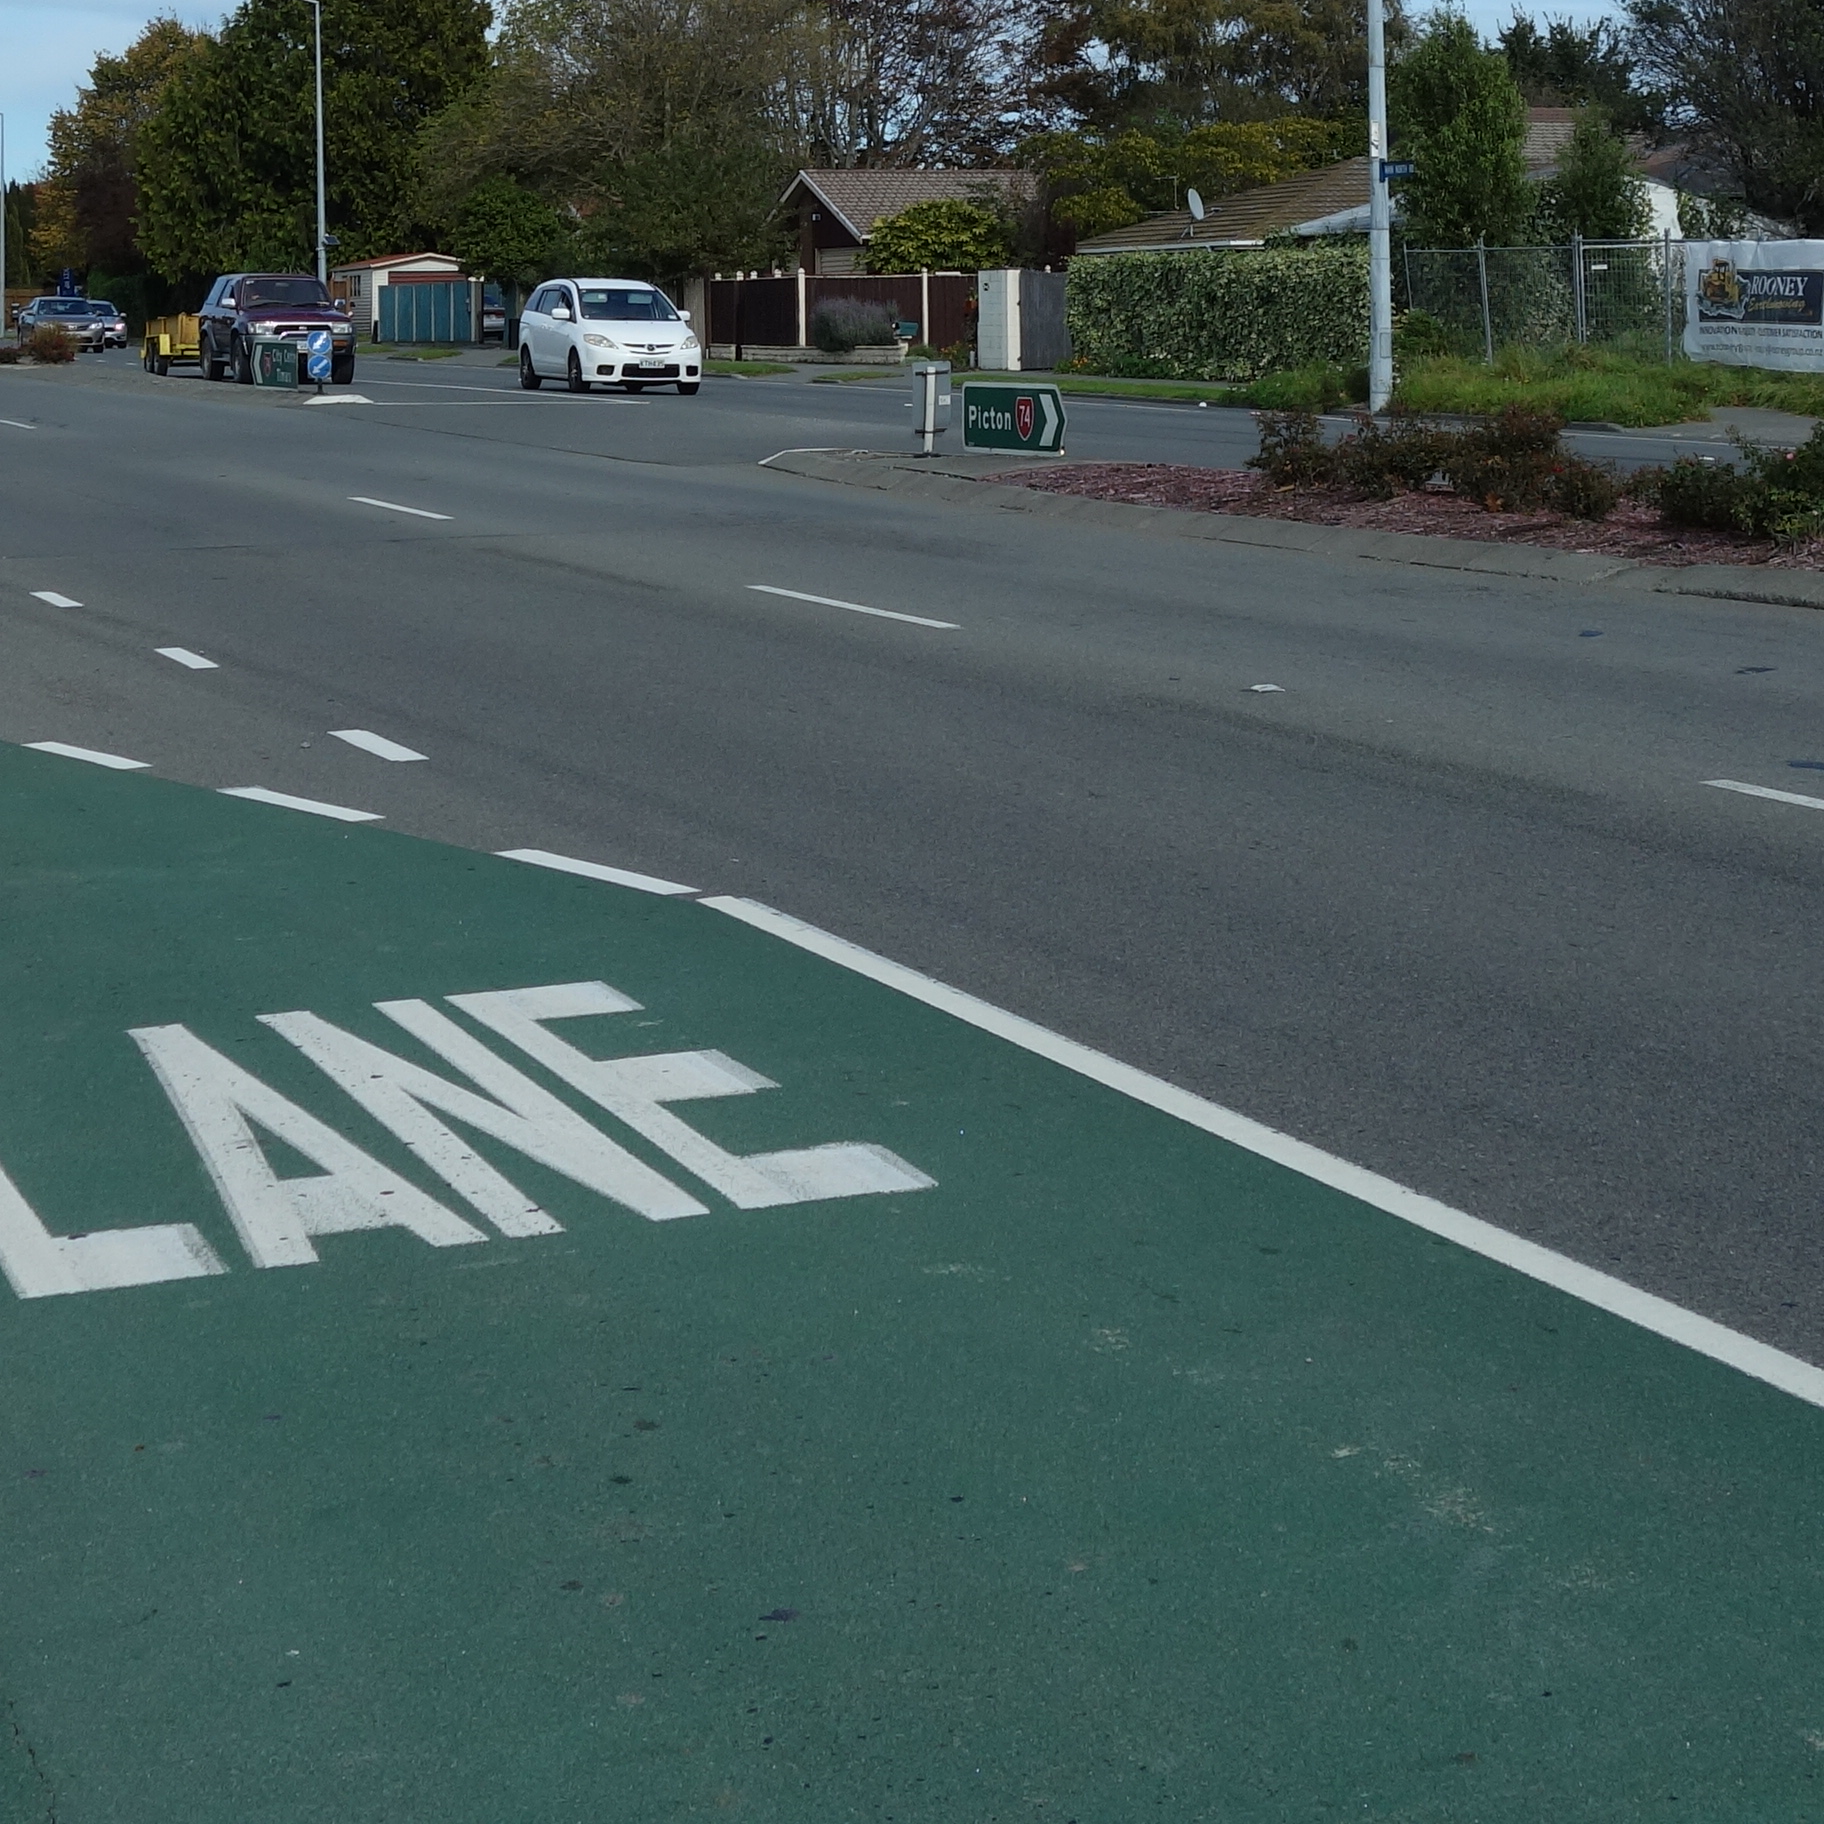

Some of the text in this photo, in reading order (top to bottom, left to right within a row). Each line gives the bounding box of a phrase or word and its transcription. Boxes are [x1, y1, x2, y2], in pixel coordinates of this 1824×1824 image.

[1750, 275, 1809, 297] ROONEY
[968, 405, 1031, 431] Picton 74
